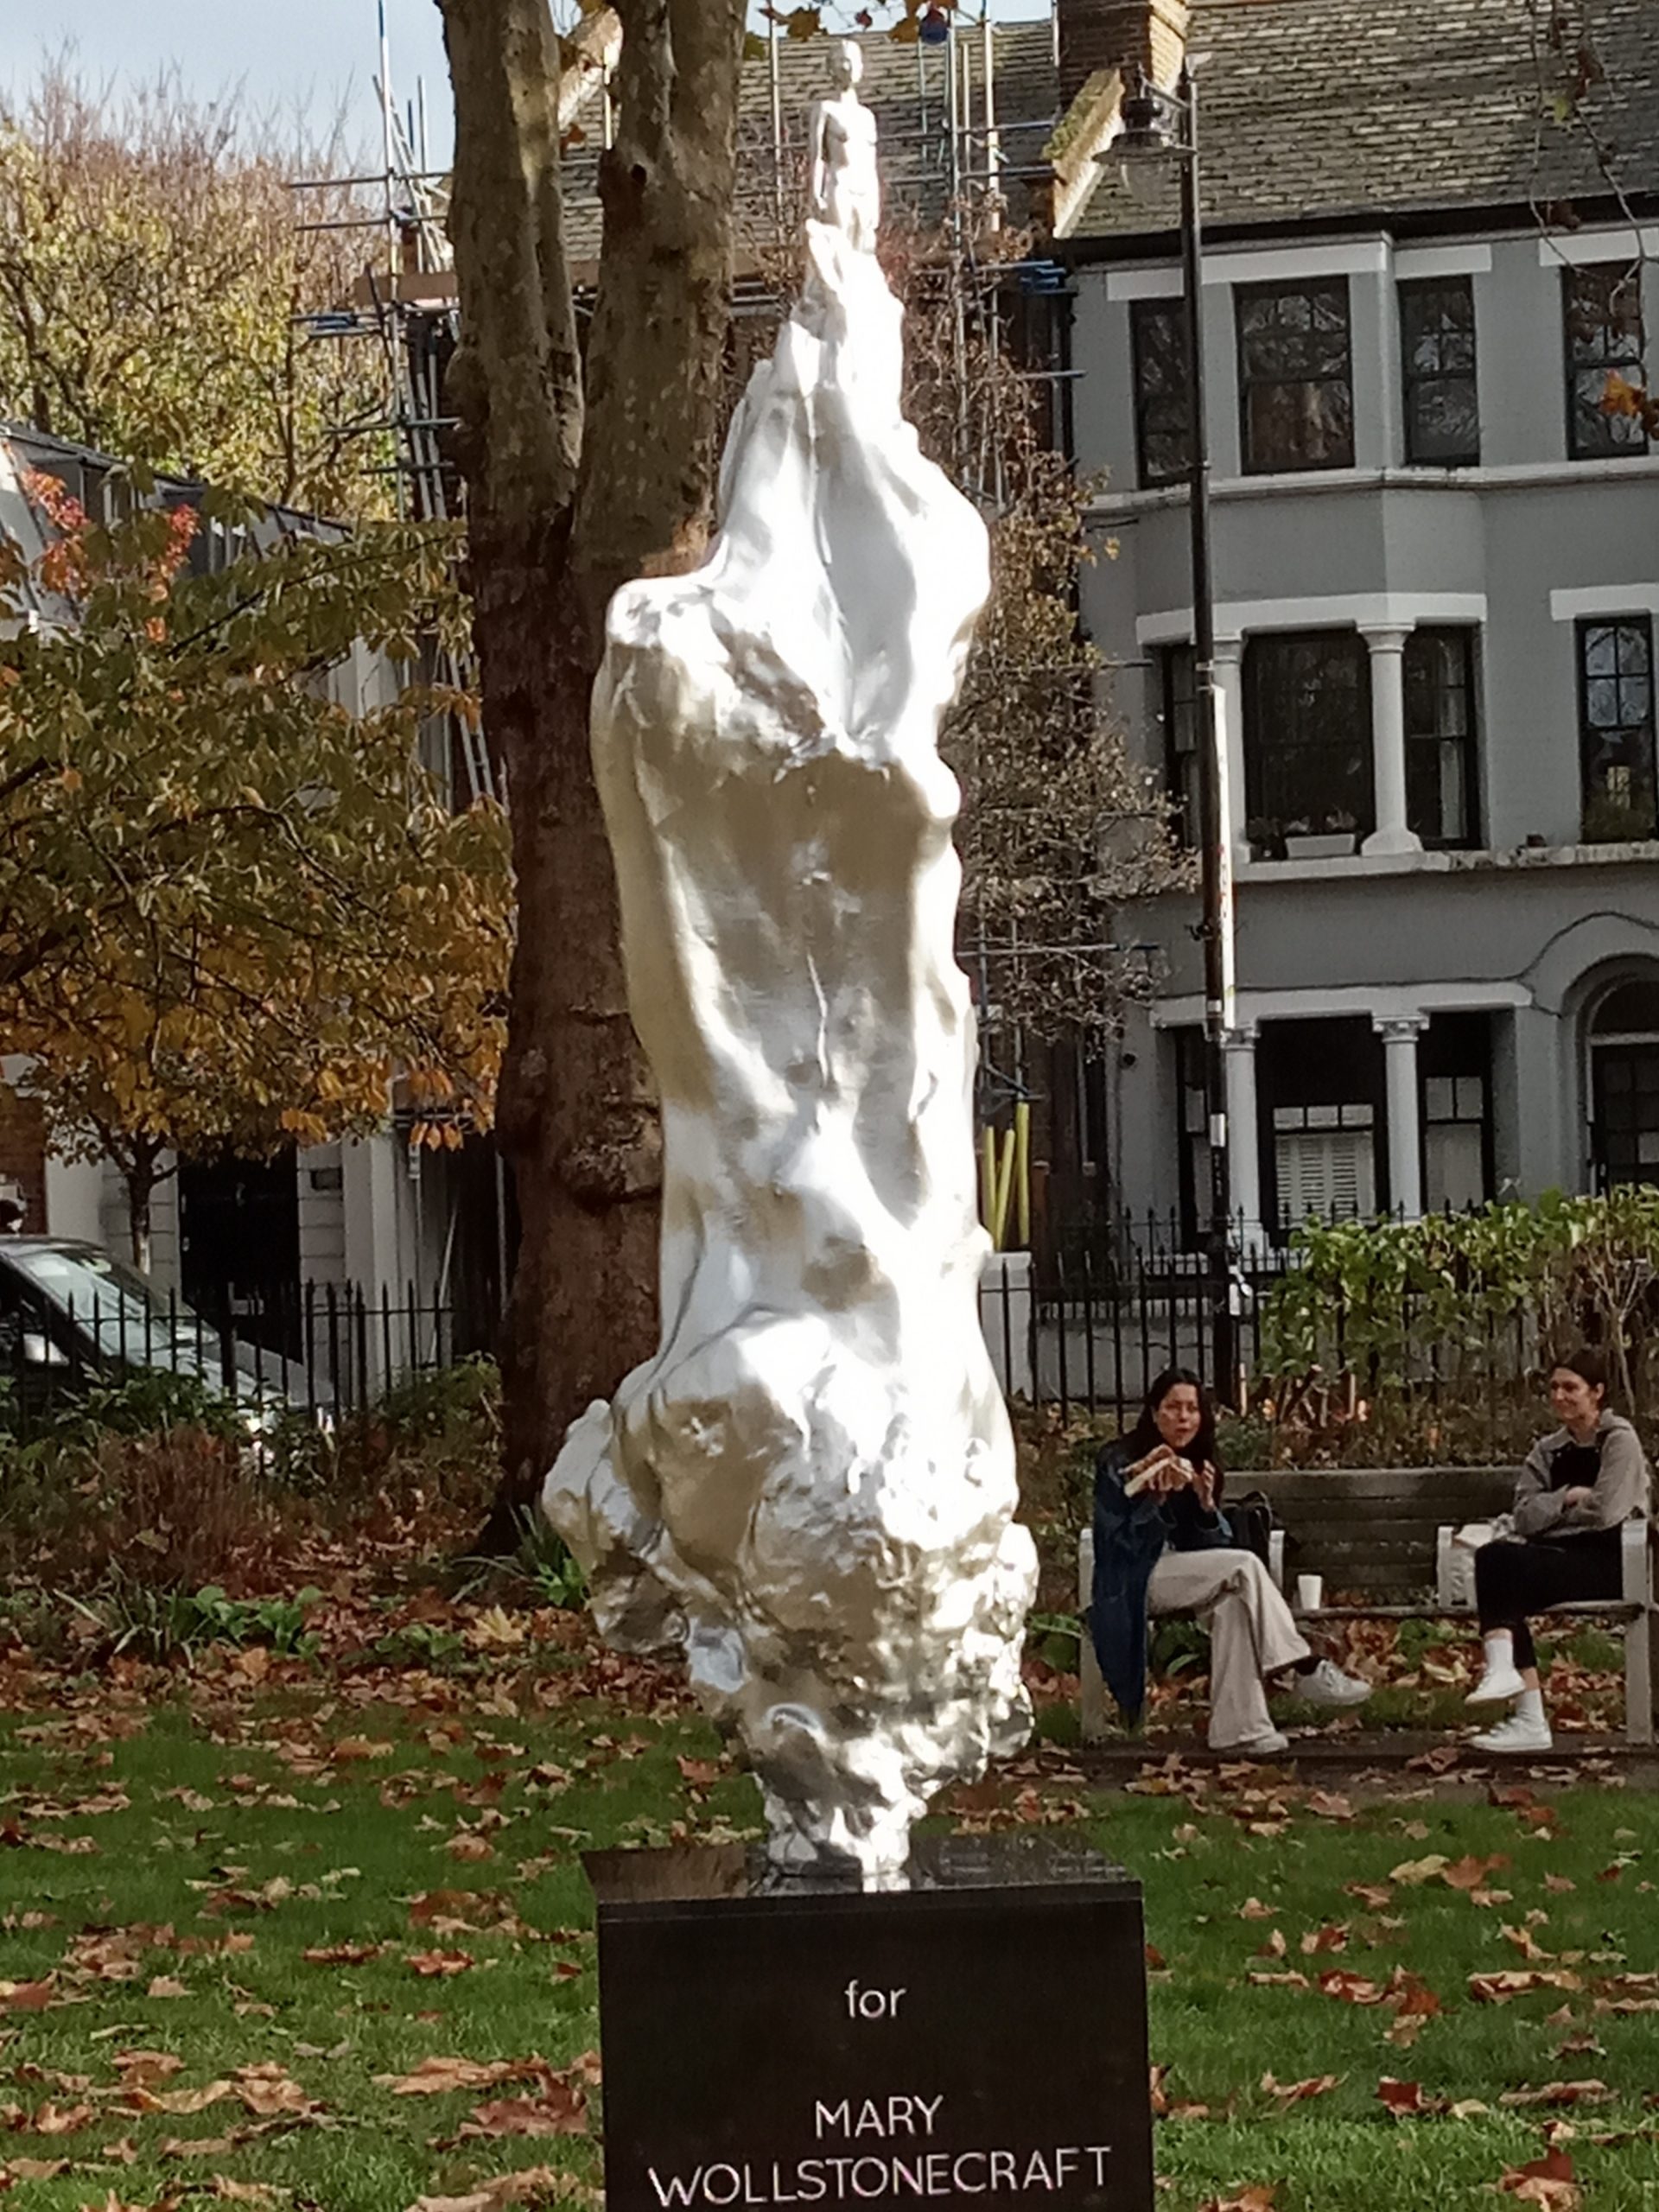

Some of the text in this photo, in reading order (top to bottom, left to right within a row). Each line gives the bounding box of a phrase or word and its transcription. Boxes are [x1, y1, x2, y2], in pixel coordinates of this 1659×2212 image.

[844, 1979, 906, 2018] for
[815, 2094, 944, 2139] MARY
[647, 2146, 1112, 2208] WOLLSTONECRAFT
